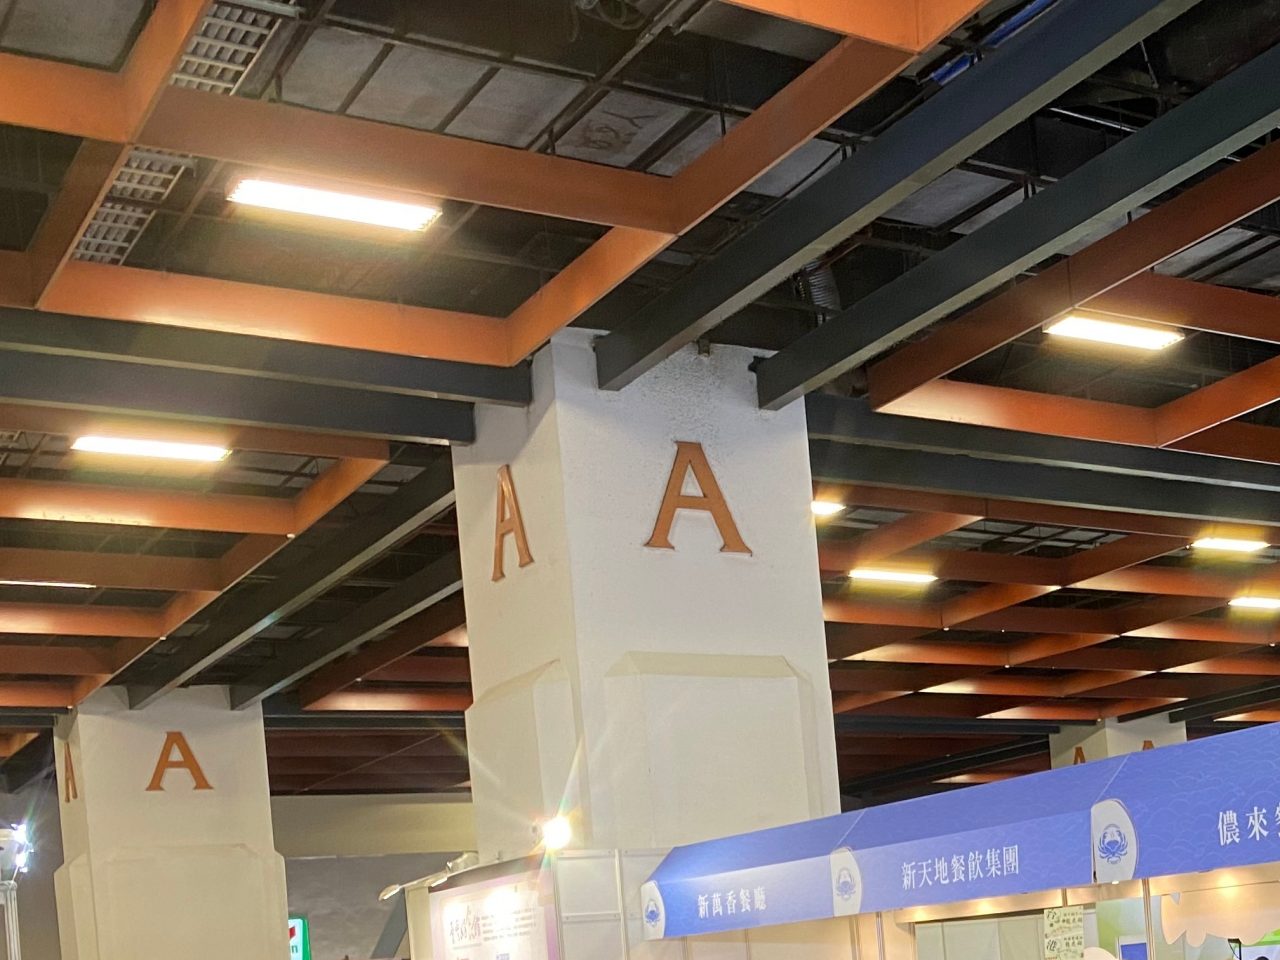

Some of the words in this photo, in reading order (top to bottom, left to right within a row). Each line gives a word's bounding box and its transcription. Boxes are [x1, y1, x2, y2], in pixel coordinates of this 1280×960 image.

[492, 464, 534, 582] A
[643, 440, 752, 556] A
[145, 731, 214, 791] A
[901, 845, 1020, 890] 新天地餐飲集團
[697, 885, 767, 919] 新萬香餐廳
